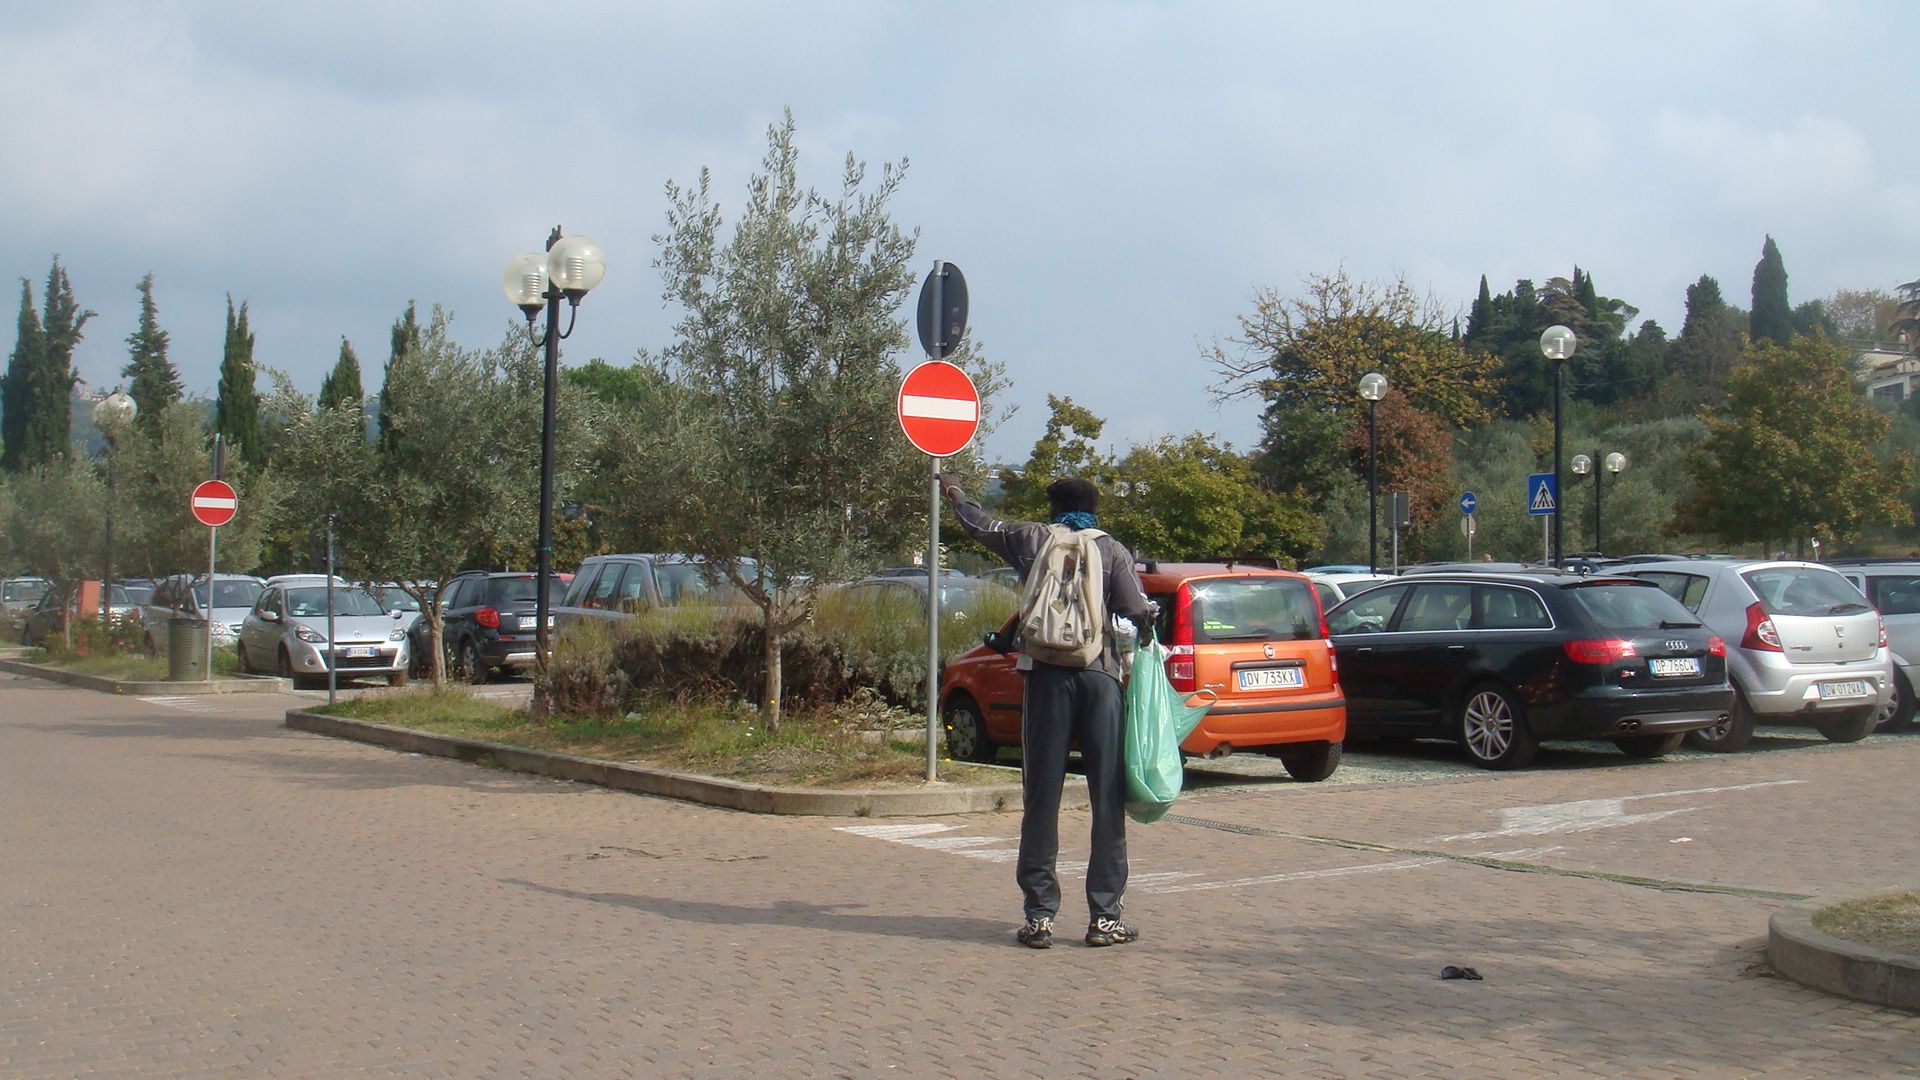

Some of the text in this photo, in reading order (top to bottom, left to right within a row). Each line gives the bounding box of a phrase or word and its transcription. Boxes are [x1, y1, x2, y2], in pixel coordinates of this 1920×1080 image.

[1655, 659, 1694, 672] DP 766CW
[1246, 670, 1295, 685] DV 733KX
